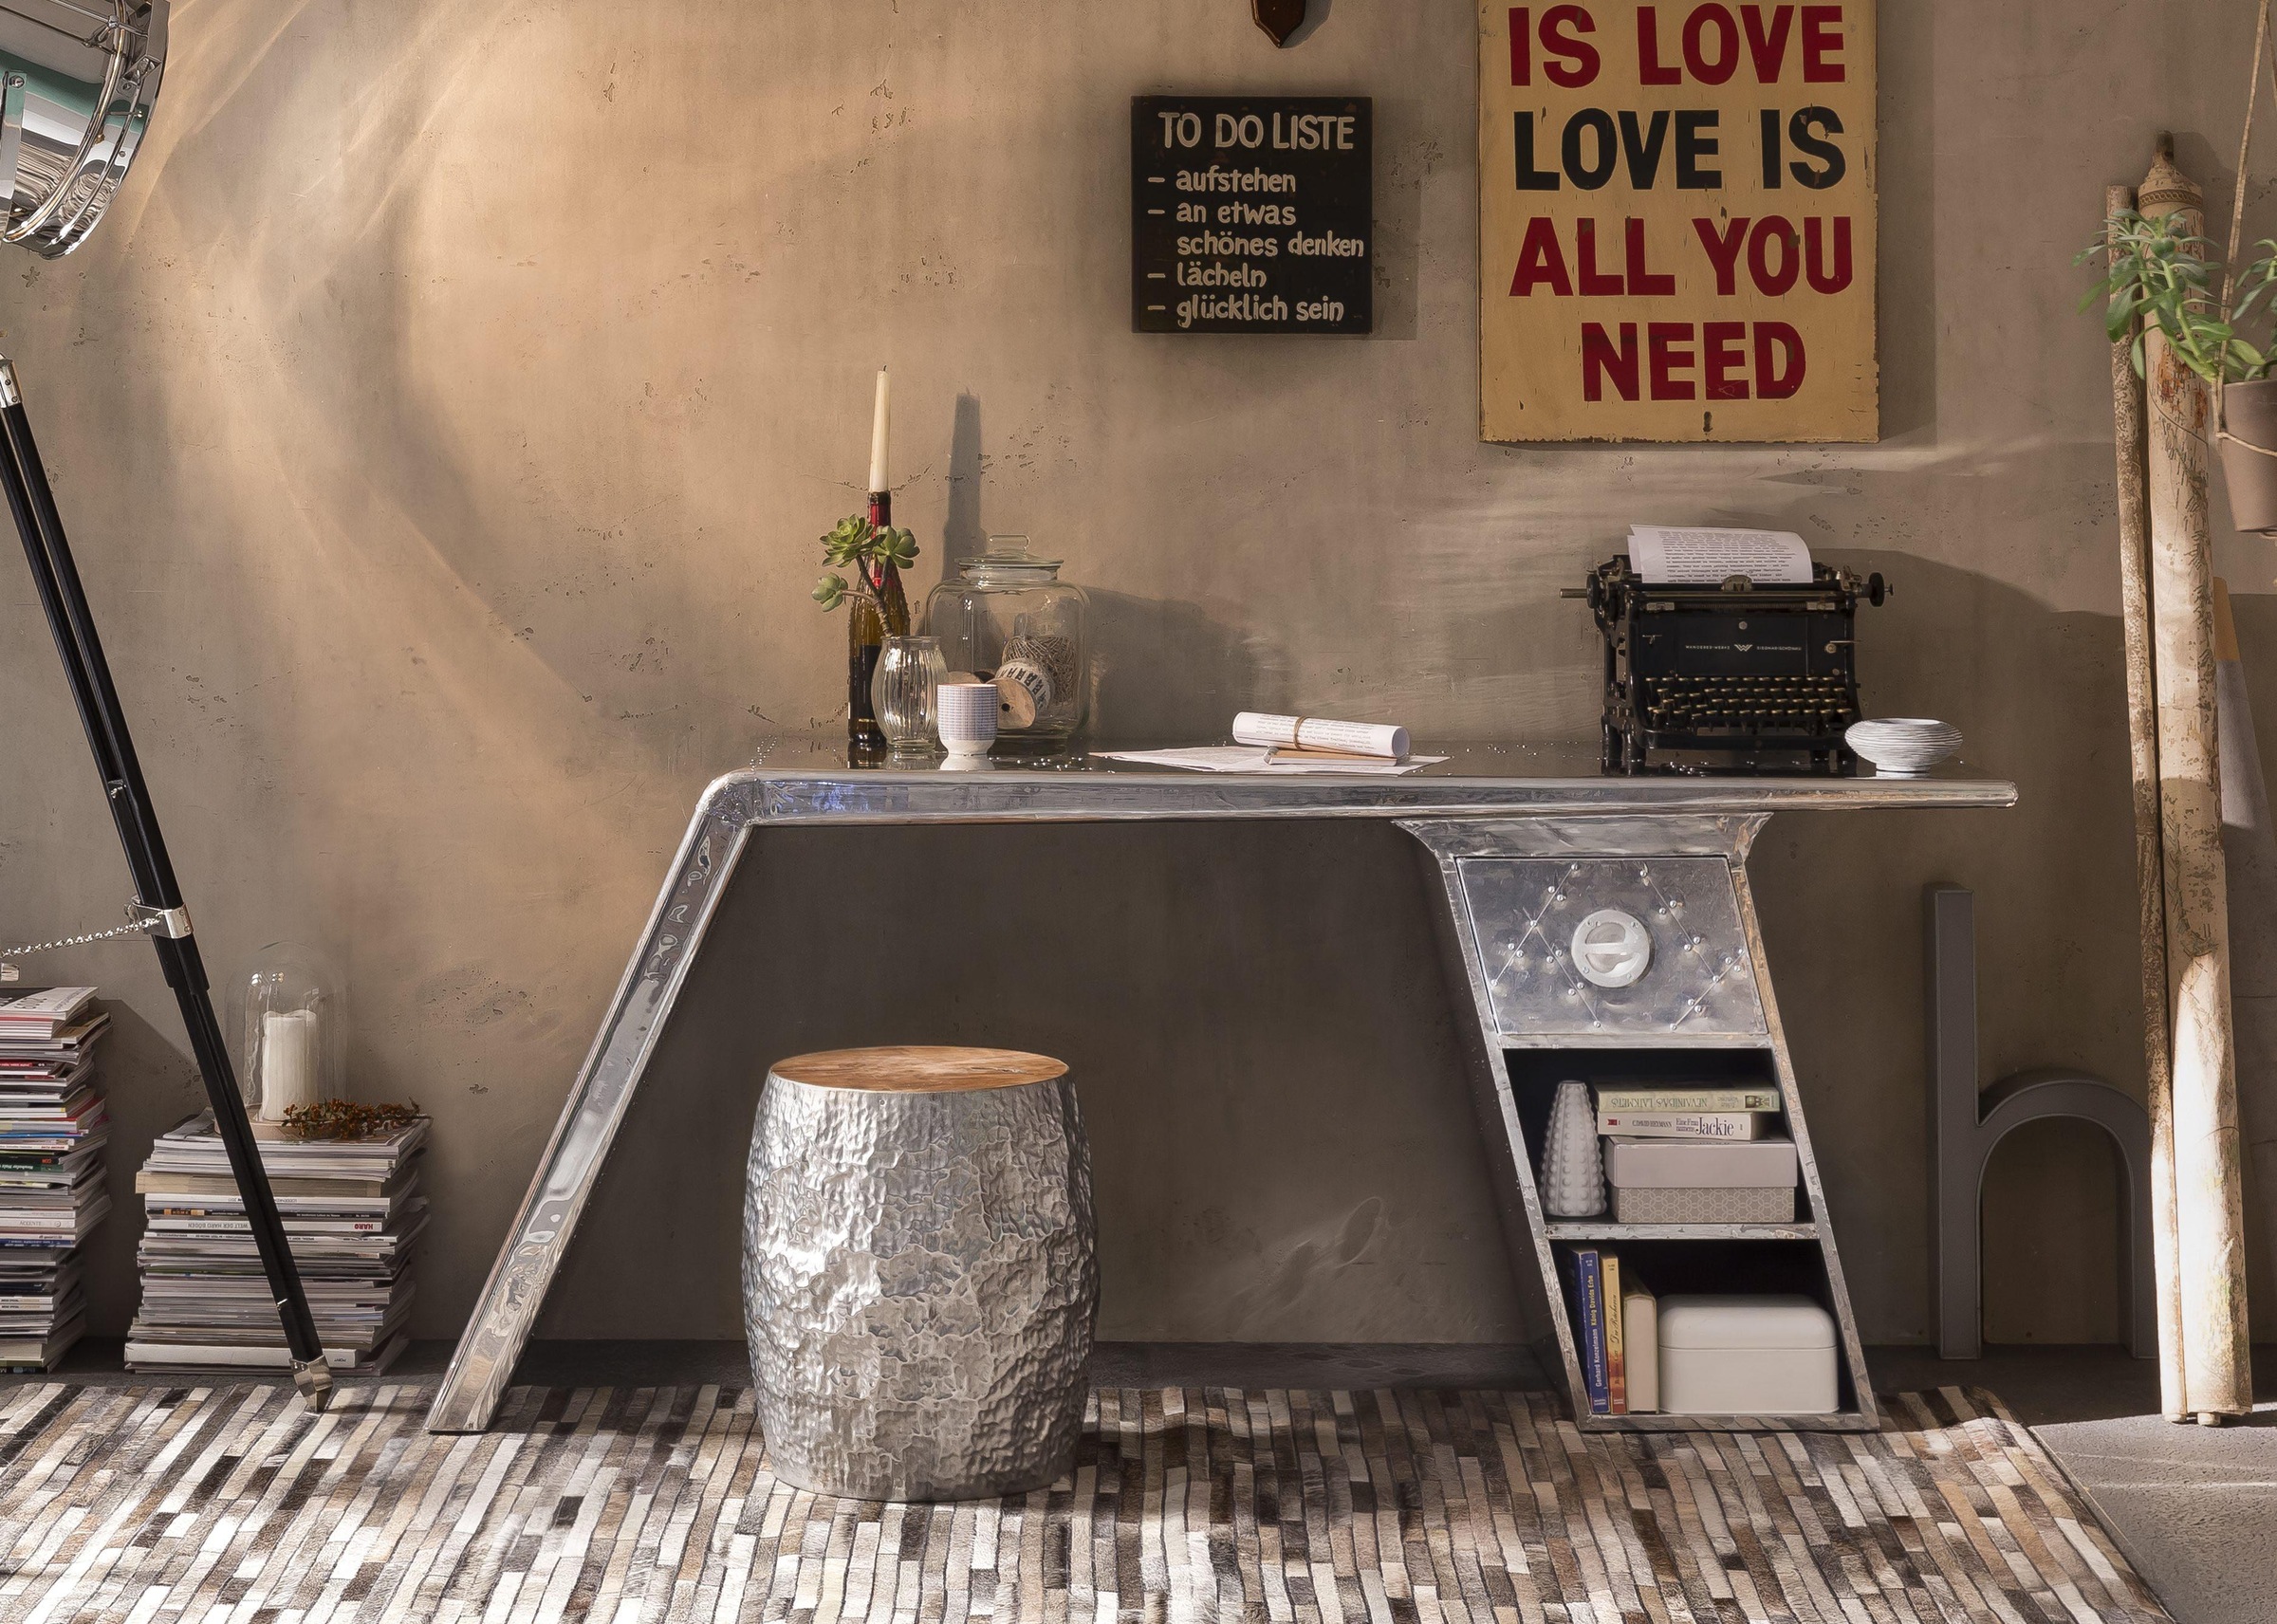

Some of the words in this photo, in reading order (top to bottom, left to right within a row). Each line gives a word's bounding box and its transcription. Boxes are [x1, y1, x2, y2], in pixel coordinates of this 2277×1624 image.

[1508, 4, 1601, 88] IS
[1636, 3, 1846, 86] LOVE
[1157, 112, 1202, 148] TO
[1214, 113, 1264, 149] DO
[1272, 112, 1356, 150] LISTE
[1513, 107, 1723, 192] LOVE
[1760, 105, 1847, 190] IS
[1176, 165, 1297, 193] aufstehen
[1176, 202, 1207, 223] an
[1217, 201, 1297, 226] etwas
[1176, 230, 1279, 257] schönes
[1287, 230, 1364, 257] denken
[1508, 216, 1676, 297] ALL
[1691, 214, 1854, 297] YOU
[1176, 261, 1268, 287] lächeln
[1176, 293, 1288, 328] glücklich
[1296, 295, 1344, 322] sein
[1581, 321, 1807, 402] NEED
[1612, 1097, 1653, 1109] LAIKMETS
[1695, 1116, 1734, 1136] Jackie
[1592, 1328, 1601, 1363] Konzelmann
[1594, 1363, 1602, 1387] Gerhard
